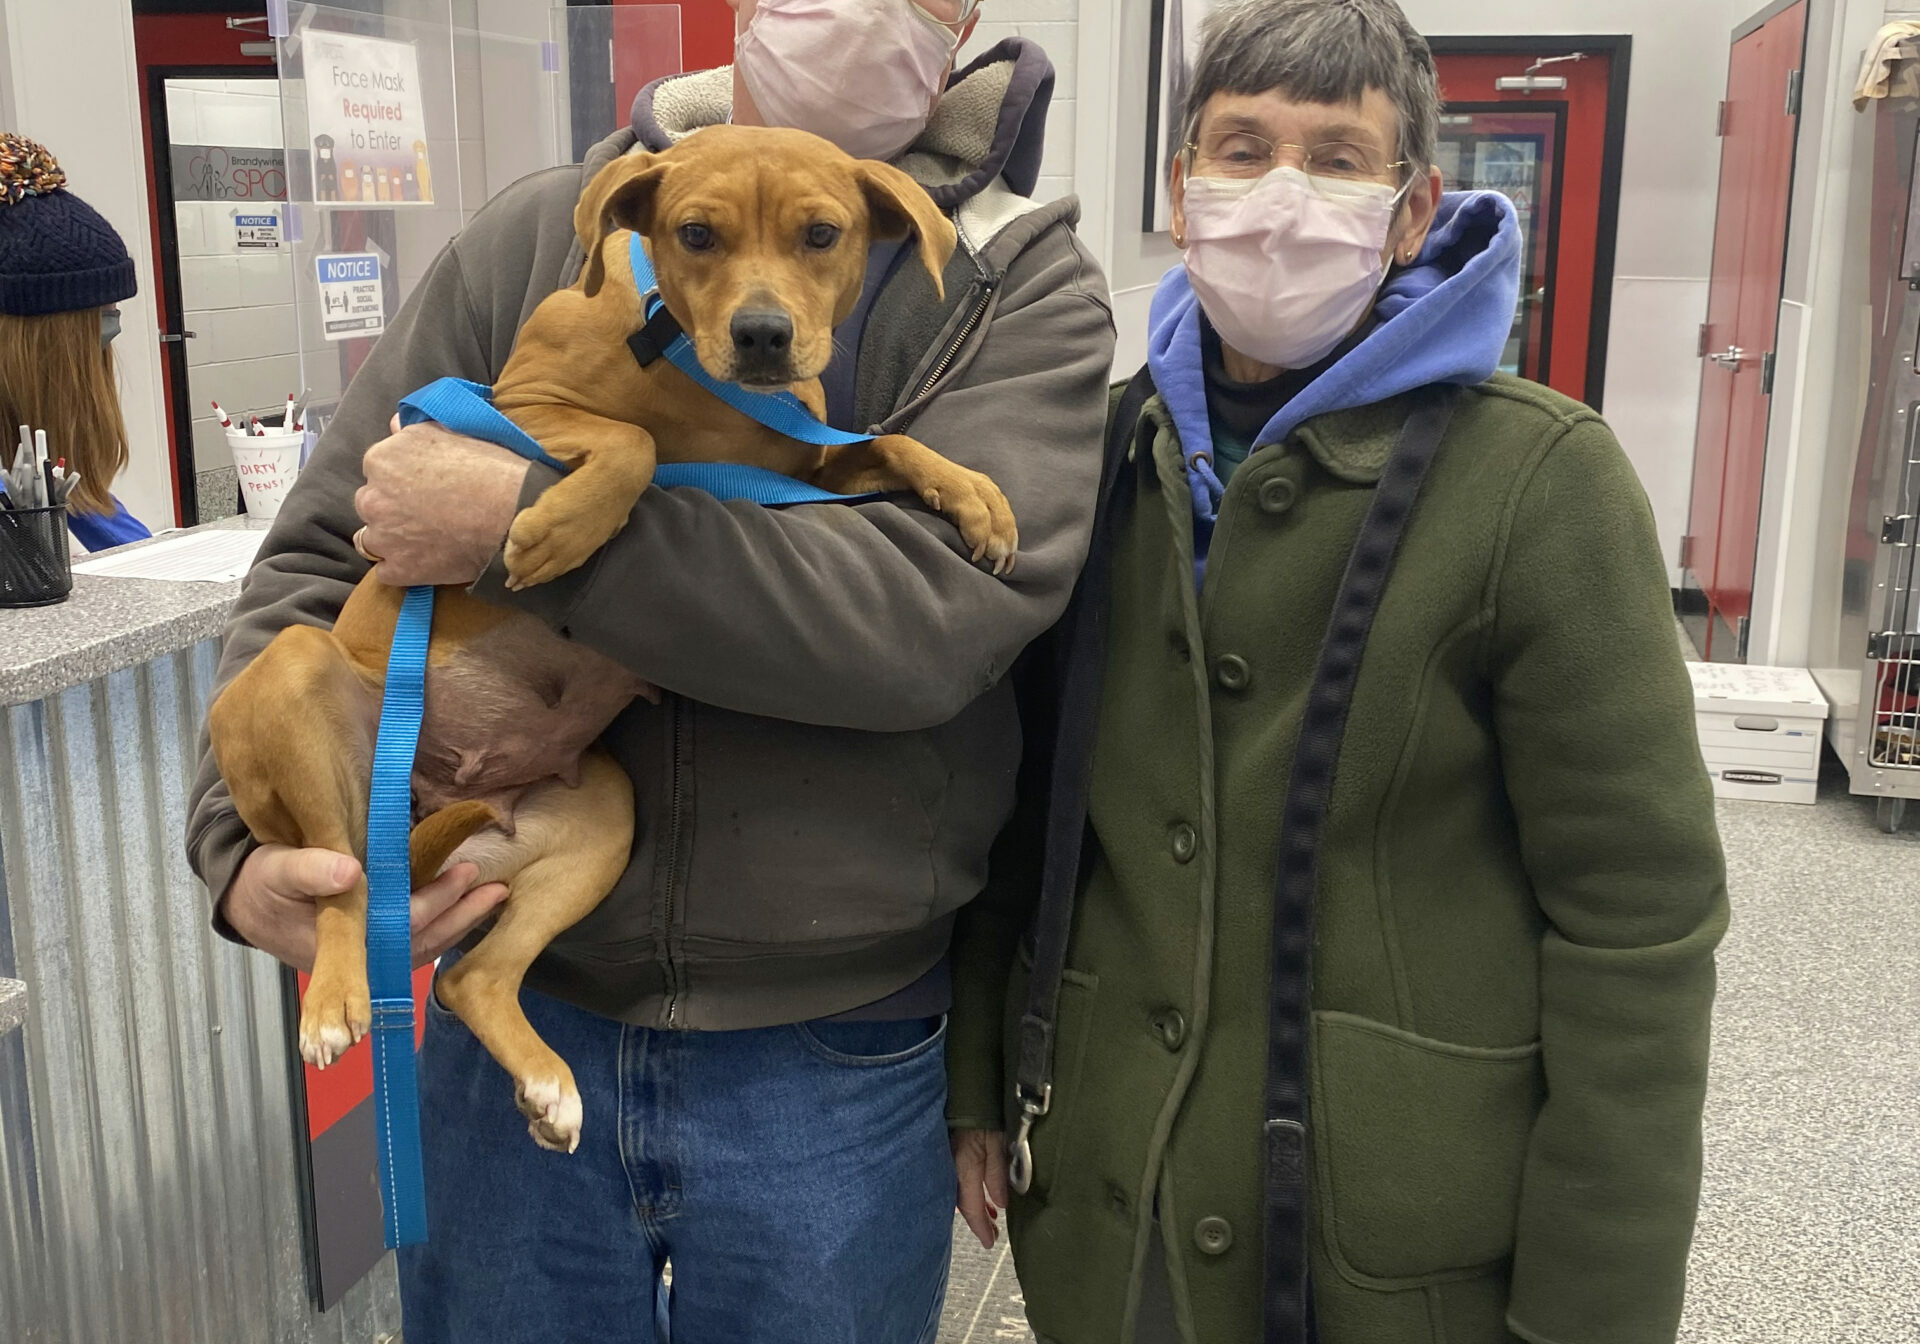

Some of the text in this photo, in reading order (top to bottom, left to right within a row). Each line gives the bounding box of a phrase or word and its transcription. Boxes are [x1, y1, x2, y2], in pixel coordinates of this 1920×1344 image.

[332, 65, 405, 92] Face Mask
[342, 97, 403, 124] Required
[350, 129, 402, 151] to Enter
[241, 217, 272, 225] NOTICE
[327, 260, 372, 279] NOTICE
[240, 462, 276, 475] DIRTY
